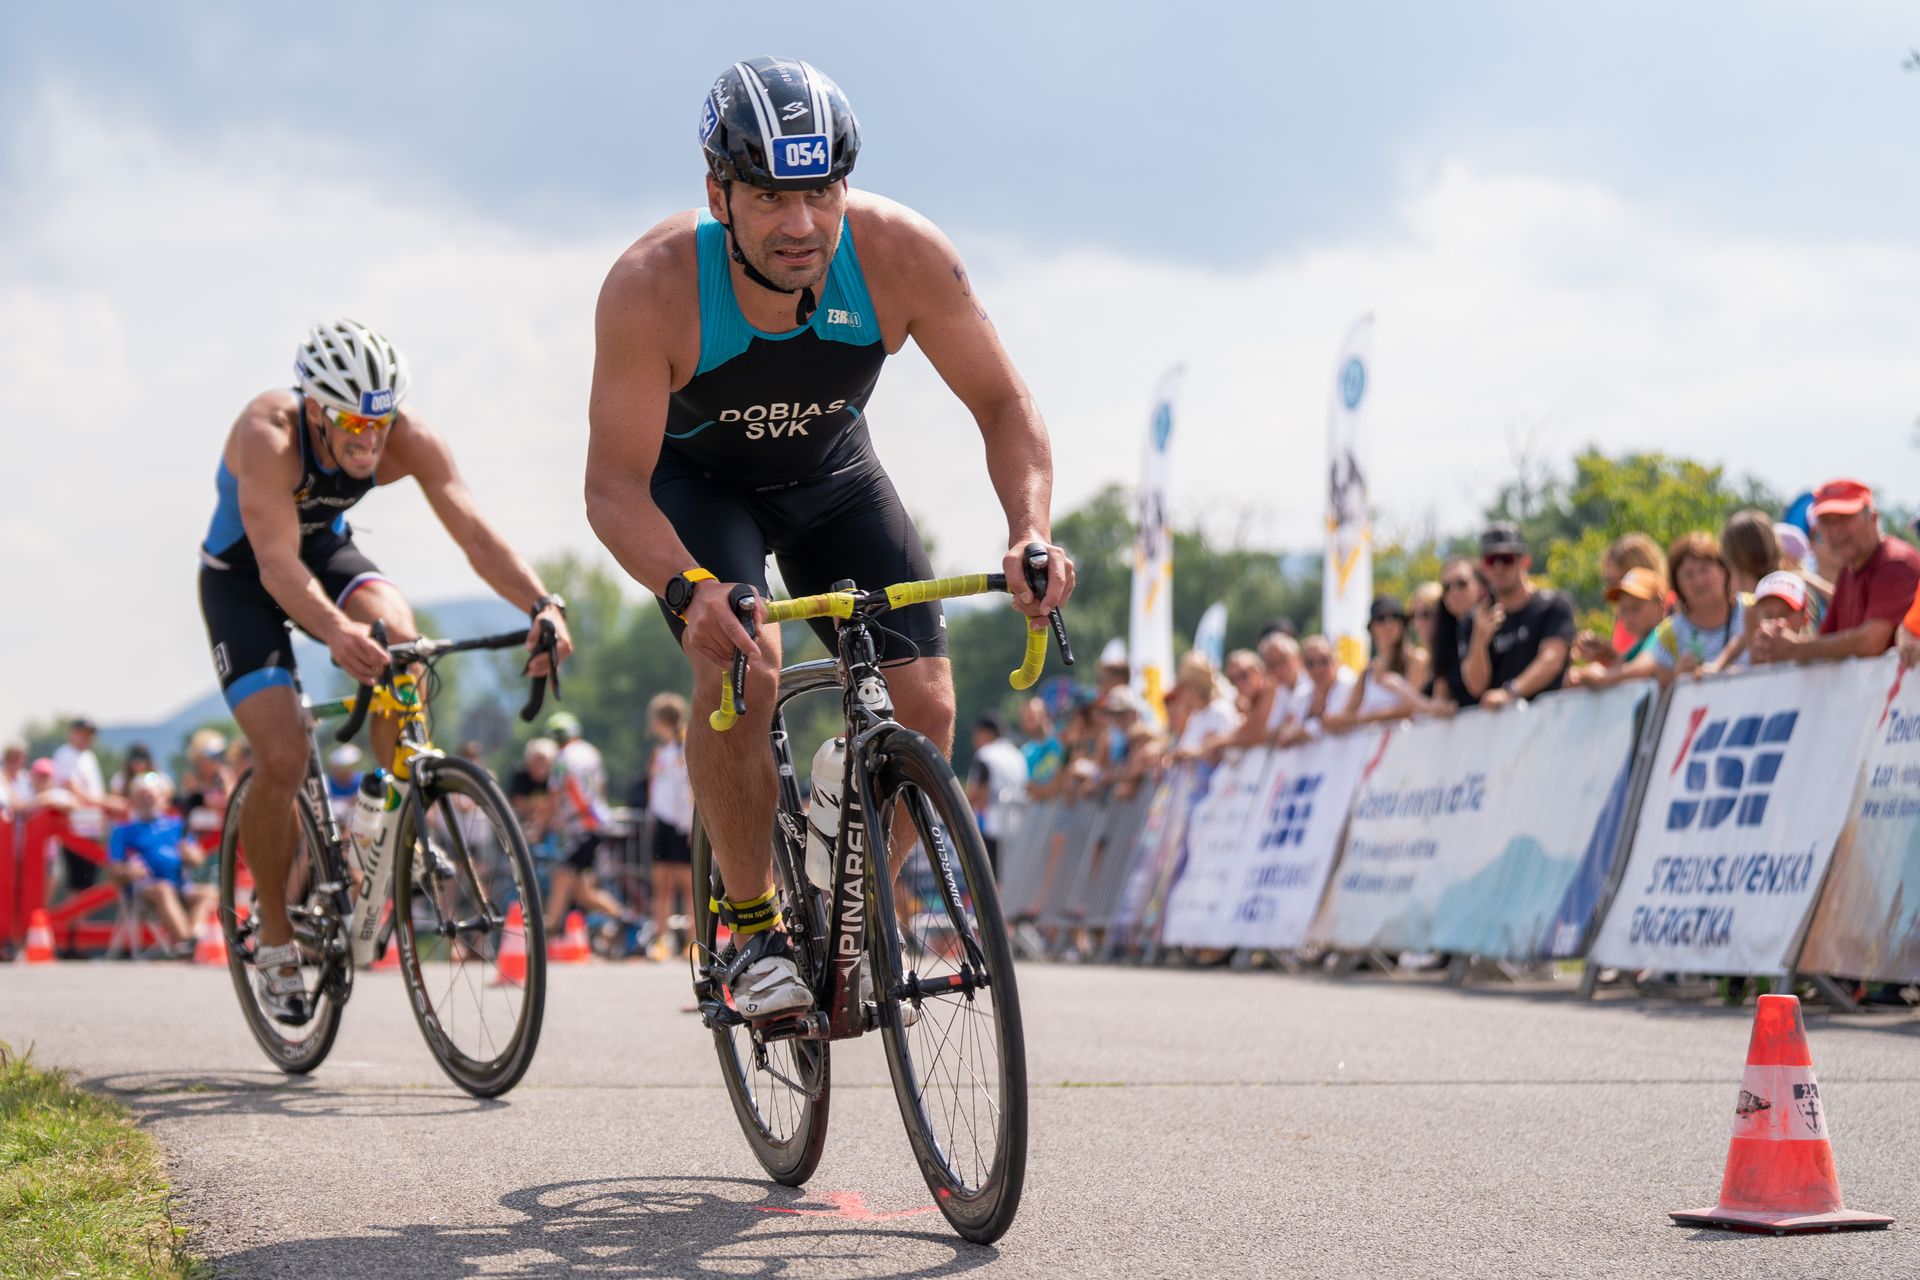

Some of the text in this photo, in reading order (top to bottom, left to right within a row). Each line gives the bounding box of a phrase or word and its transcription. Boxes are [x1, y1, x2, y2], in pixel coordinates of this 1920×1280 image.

[785, 141, 826, 167] 054
[718, 399, 847, 423] DOBIAS
[745, 418, 812, 440] SVK
[931, 826, 963, 908] PINARELLO
